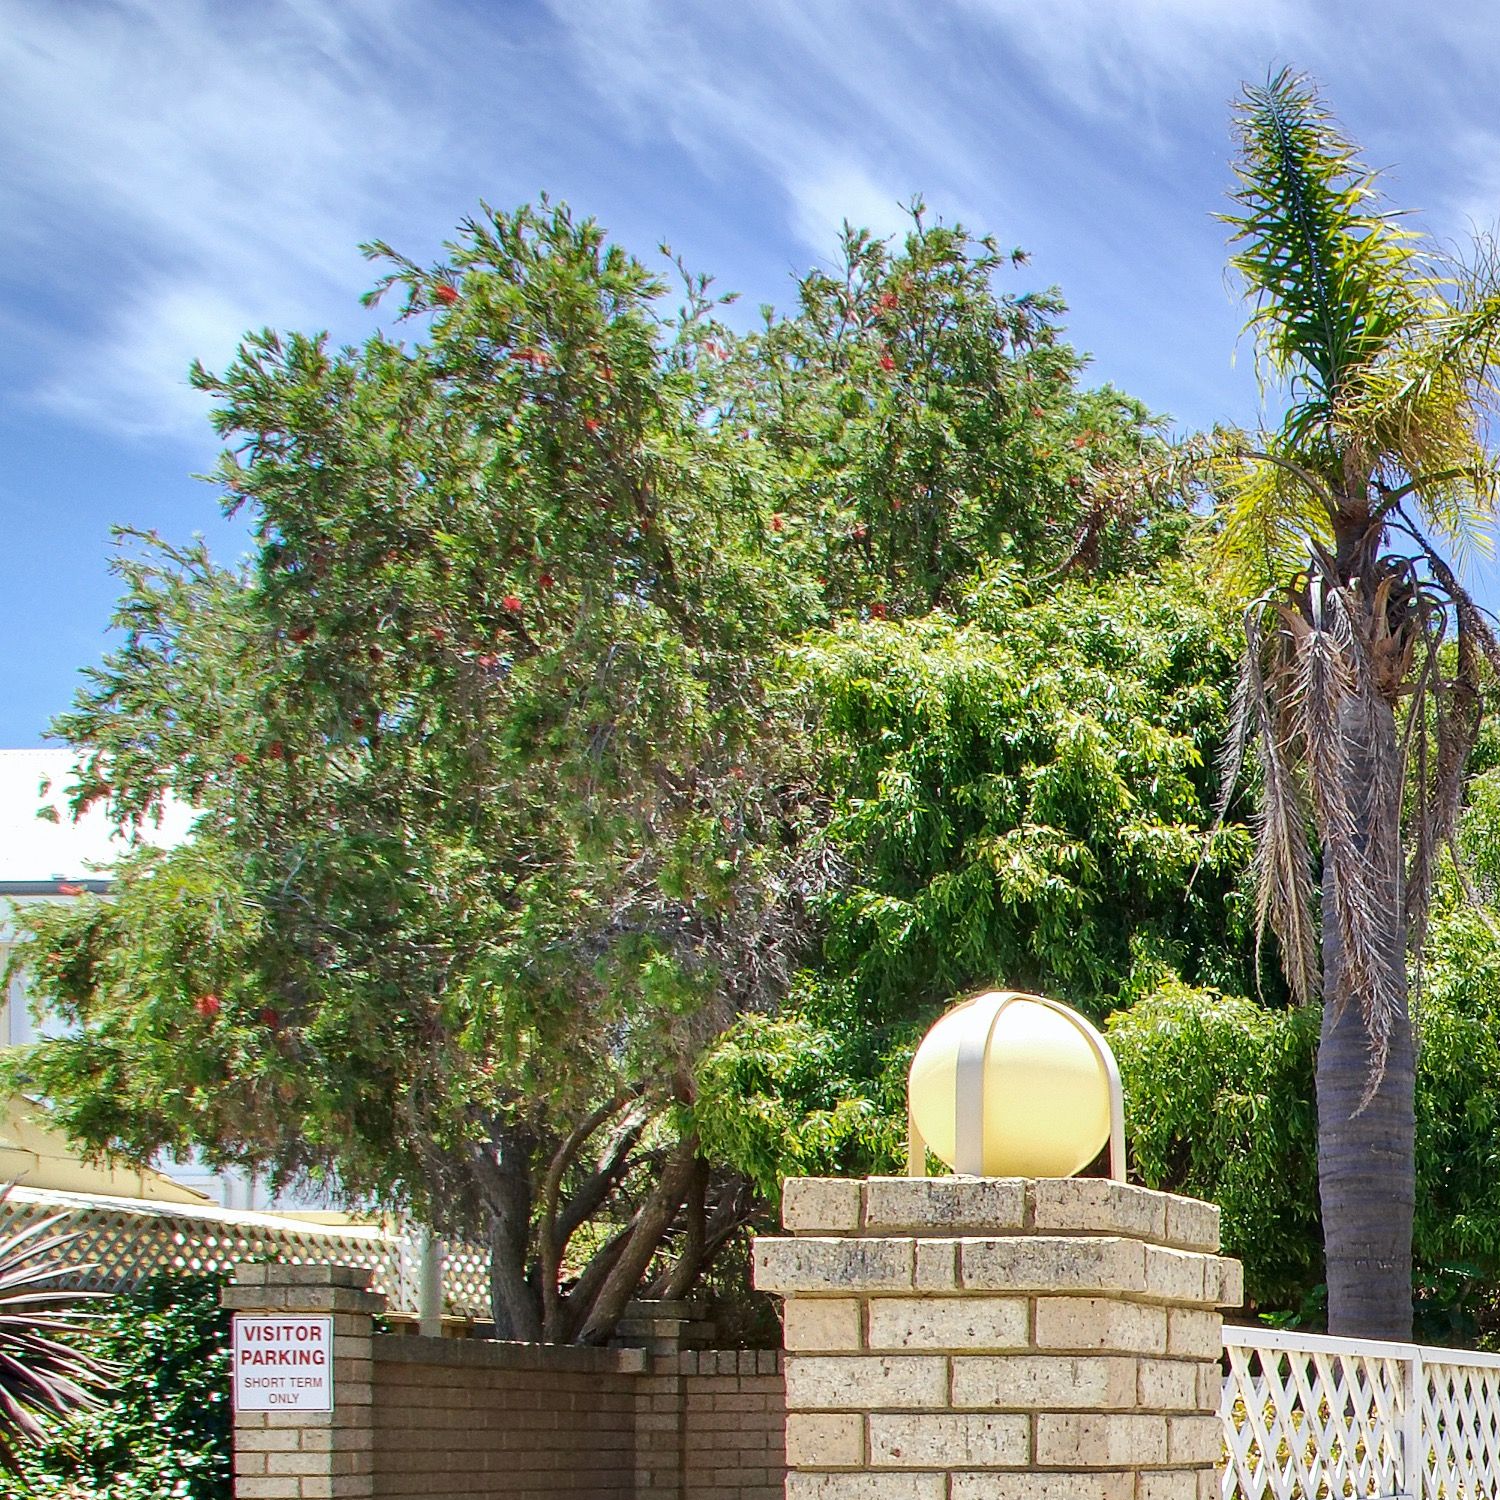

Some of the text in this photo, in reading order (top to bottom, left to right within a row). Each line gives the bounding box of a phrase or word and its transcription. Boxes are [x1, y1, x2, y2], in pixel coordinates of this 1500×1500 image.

[243, 1325, 322, 1342] VISITOR
[240, 1349, 326, 1366] PARKING
[244, 1377, 323, 1389] SHORT TERM
[268, 1393, 300, 1404] ONLY
